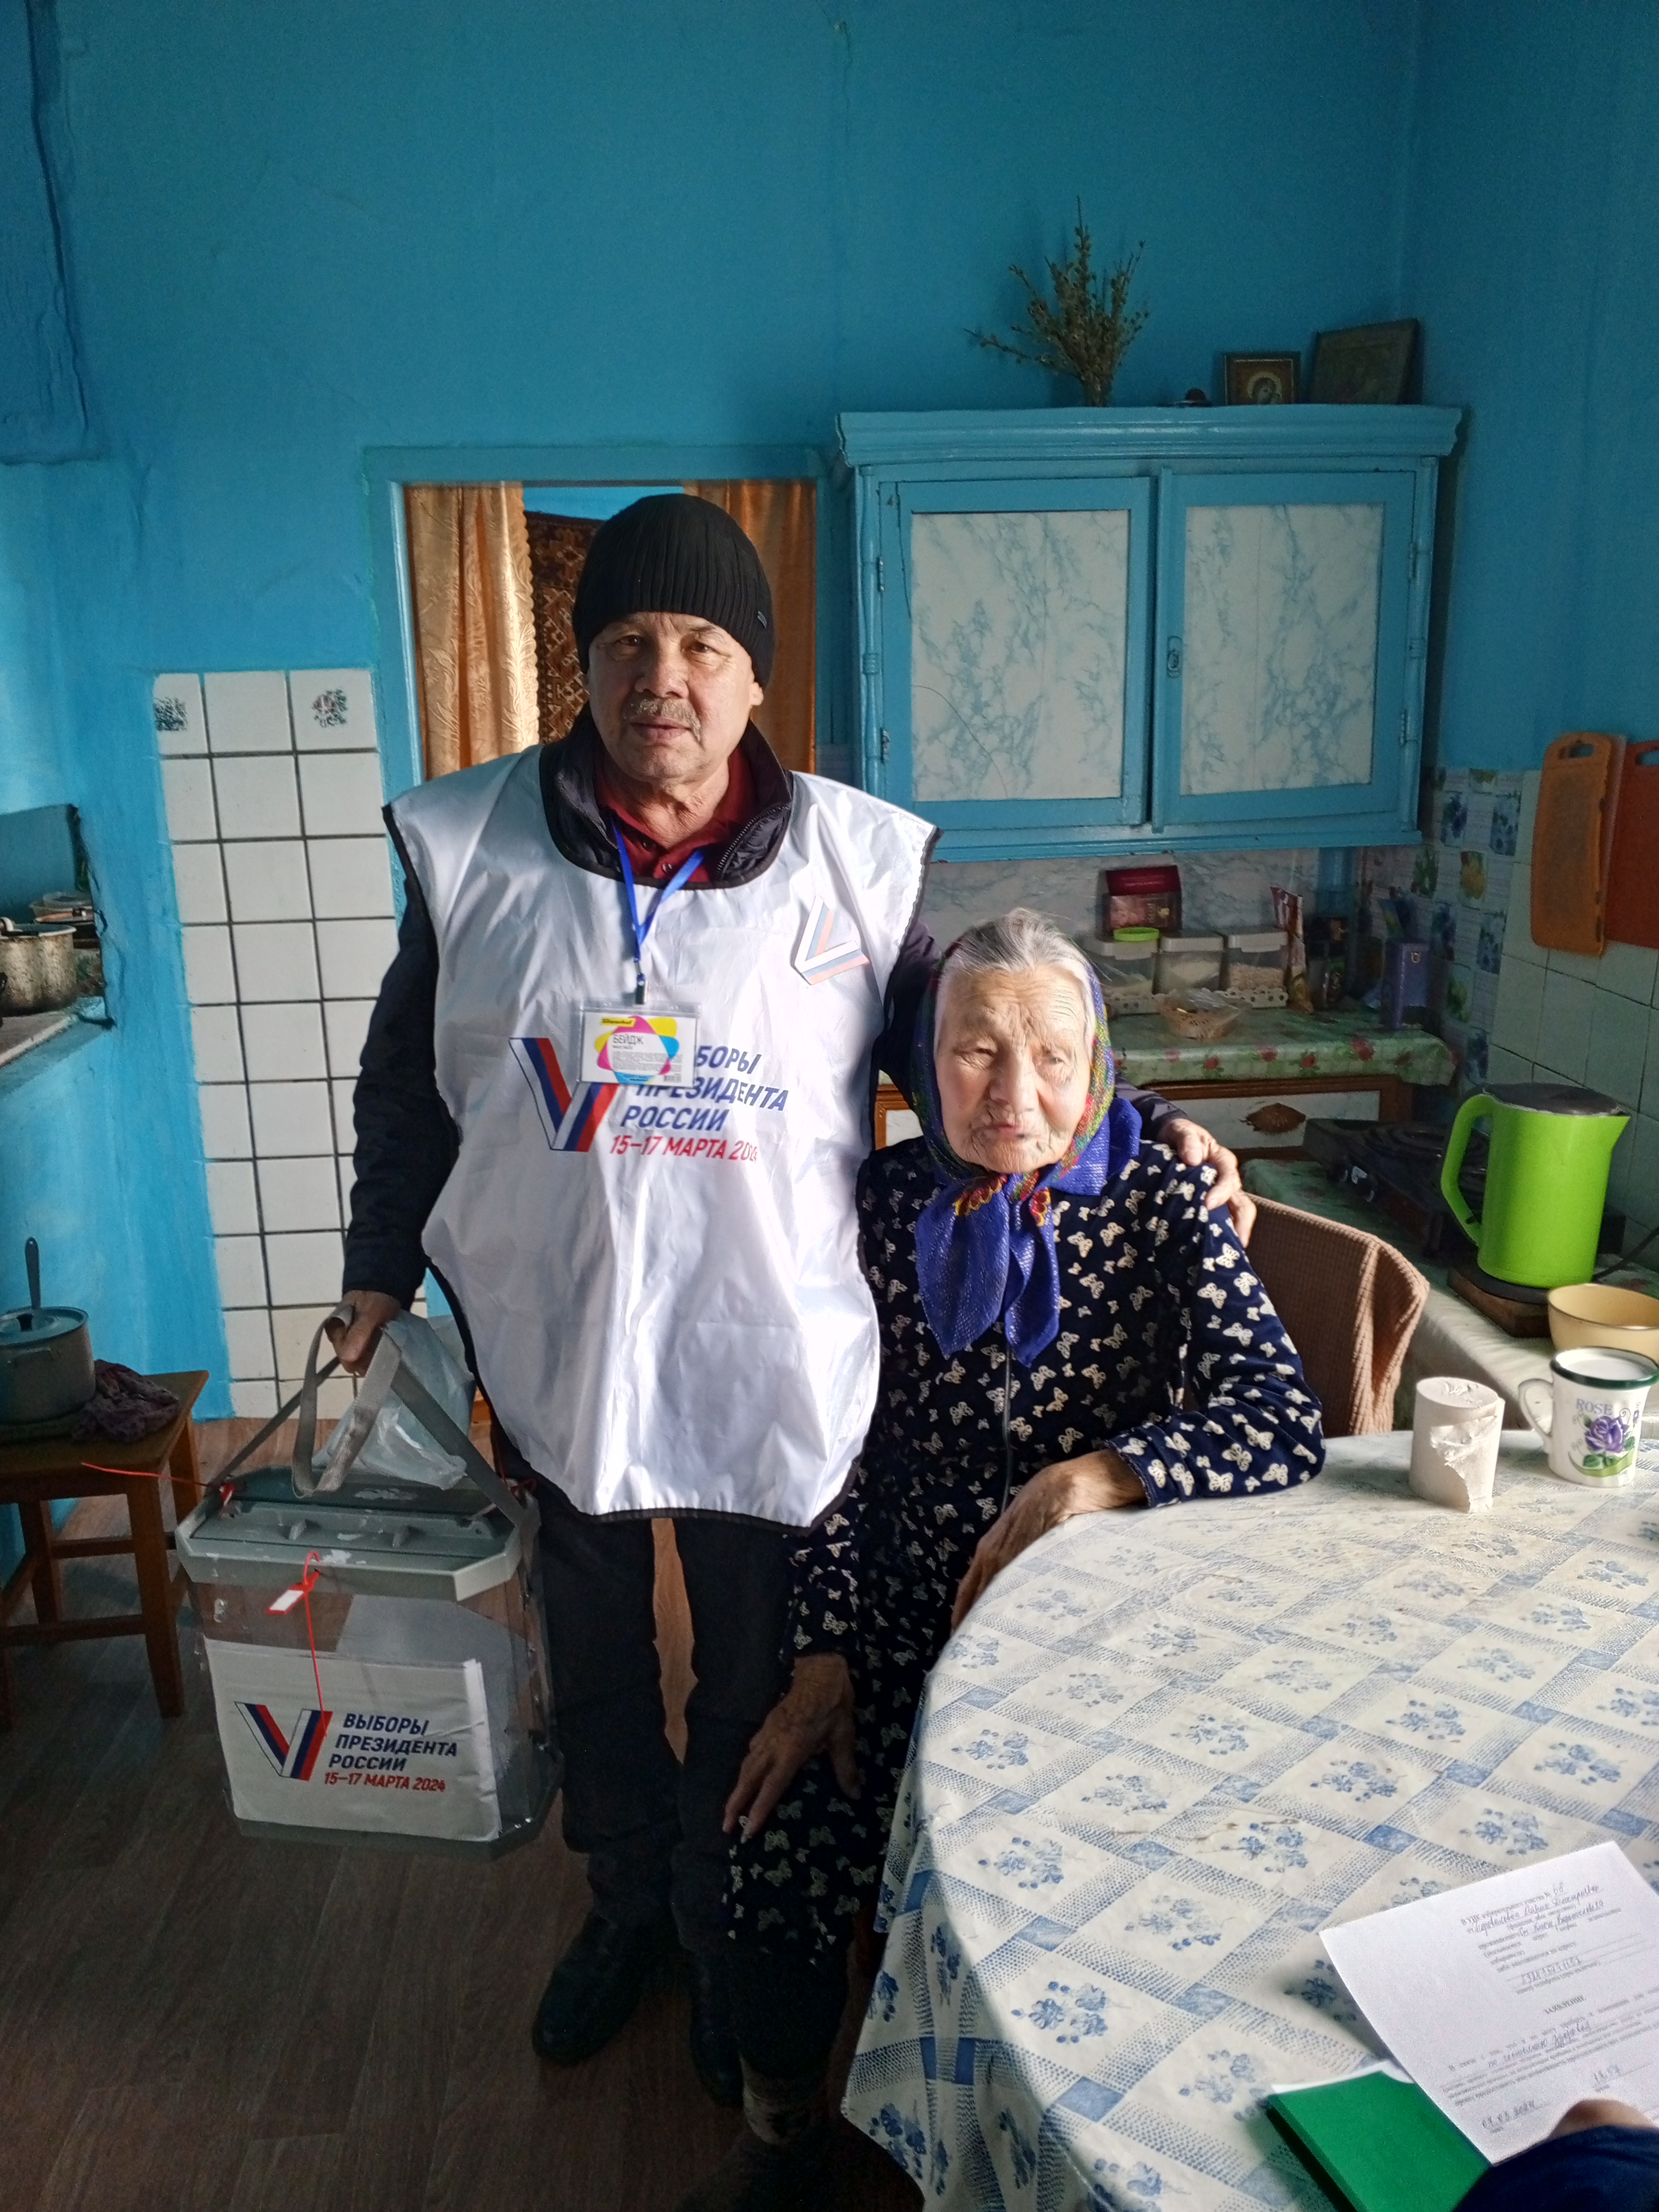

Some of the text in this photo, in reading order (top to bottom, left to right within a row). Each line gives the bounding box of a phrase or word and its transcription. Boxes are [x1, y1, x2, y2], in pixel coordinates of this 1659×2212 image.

[695, 1045, 762, 1074] БОРЫ
[620, 1105, 730, 1132] РОССИИ
[663, 1136, 728, 1160] МАРТА
[1576, 1398, 1613, 1416] ROSE
[343, 1713, 429, 1735] ВЫБОРЫ
[335, 1733, 458, 1756] ПРЕЗИДЕНТА
[328, 1753, 408, 1771] РОССИИ
[364, 1773, 410, 1790] МАРТА
[413, 1776, 446, 1792] 2024
